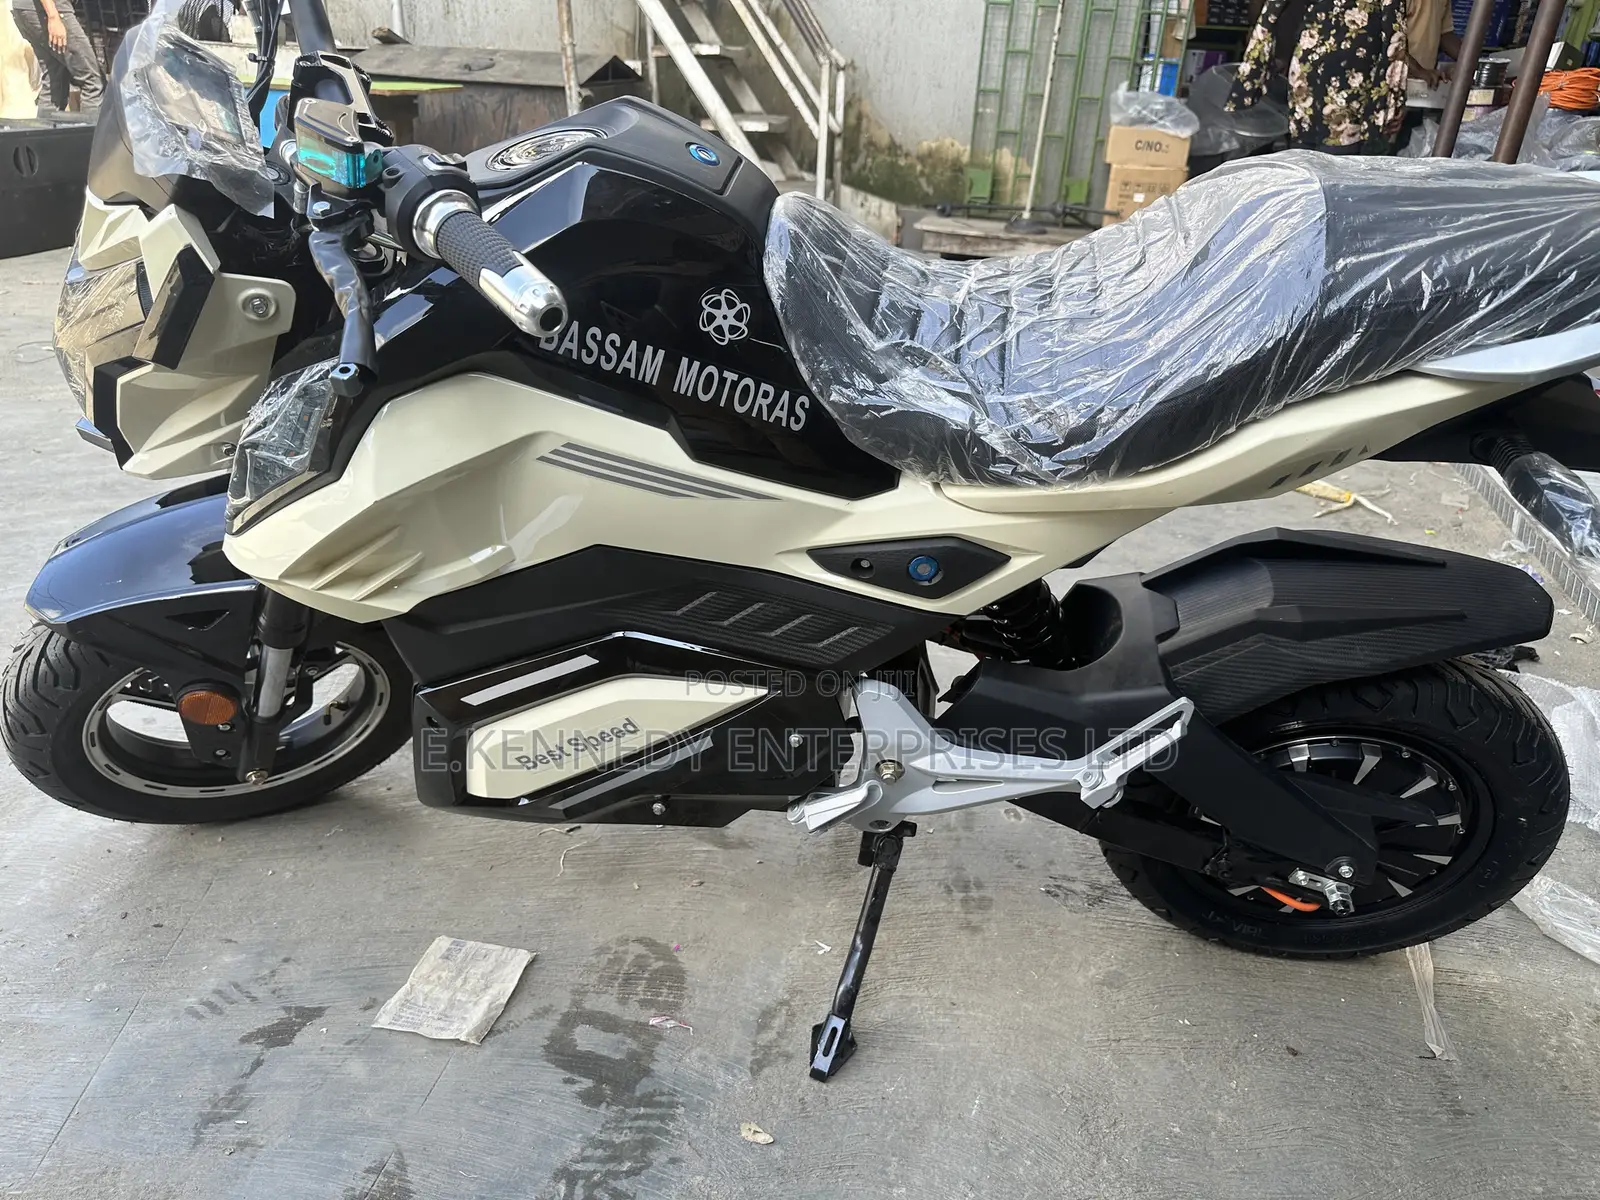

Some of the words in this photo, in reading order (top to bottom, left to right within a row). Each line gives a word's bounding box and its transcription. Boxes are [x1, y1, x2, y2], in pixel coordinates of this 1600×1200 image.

[673, 356, 810, 432] MOTORAS
[515, 744, 572, 770] Best
[567, 717, 640, 752] Speed
